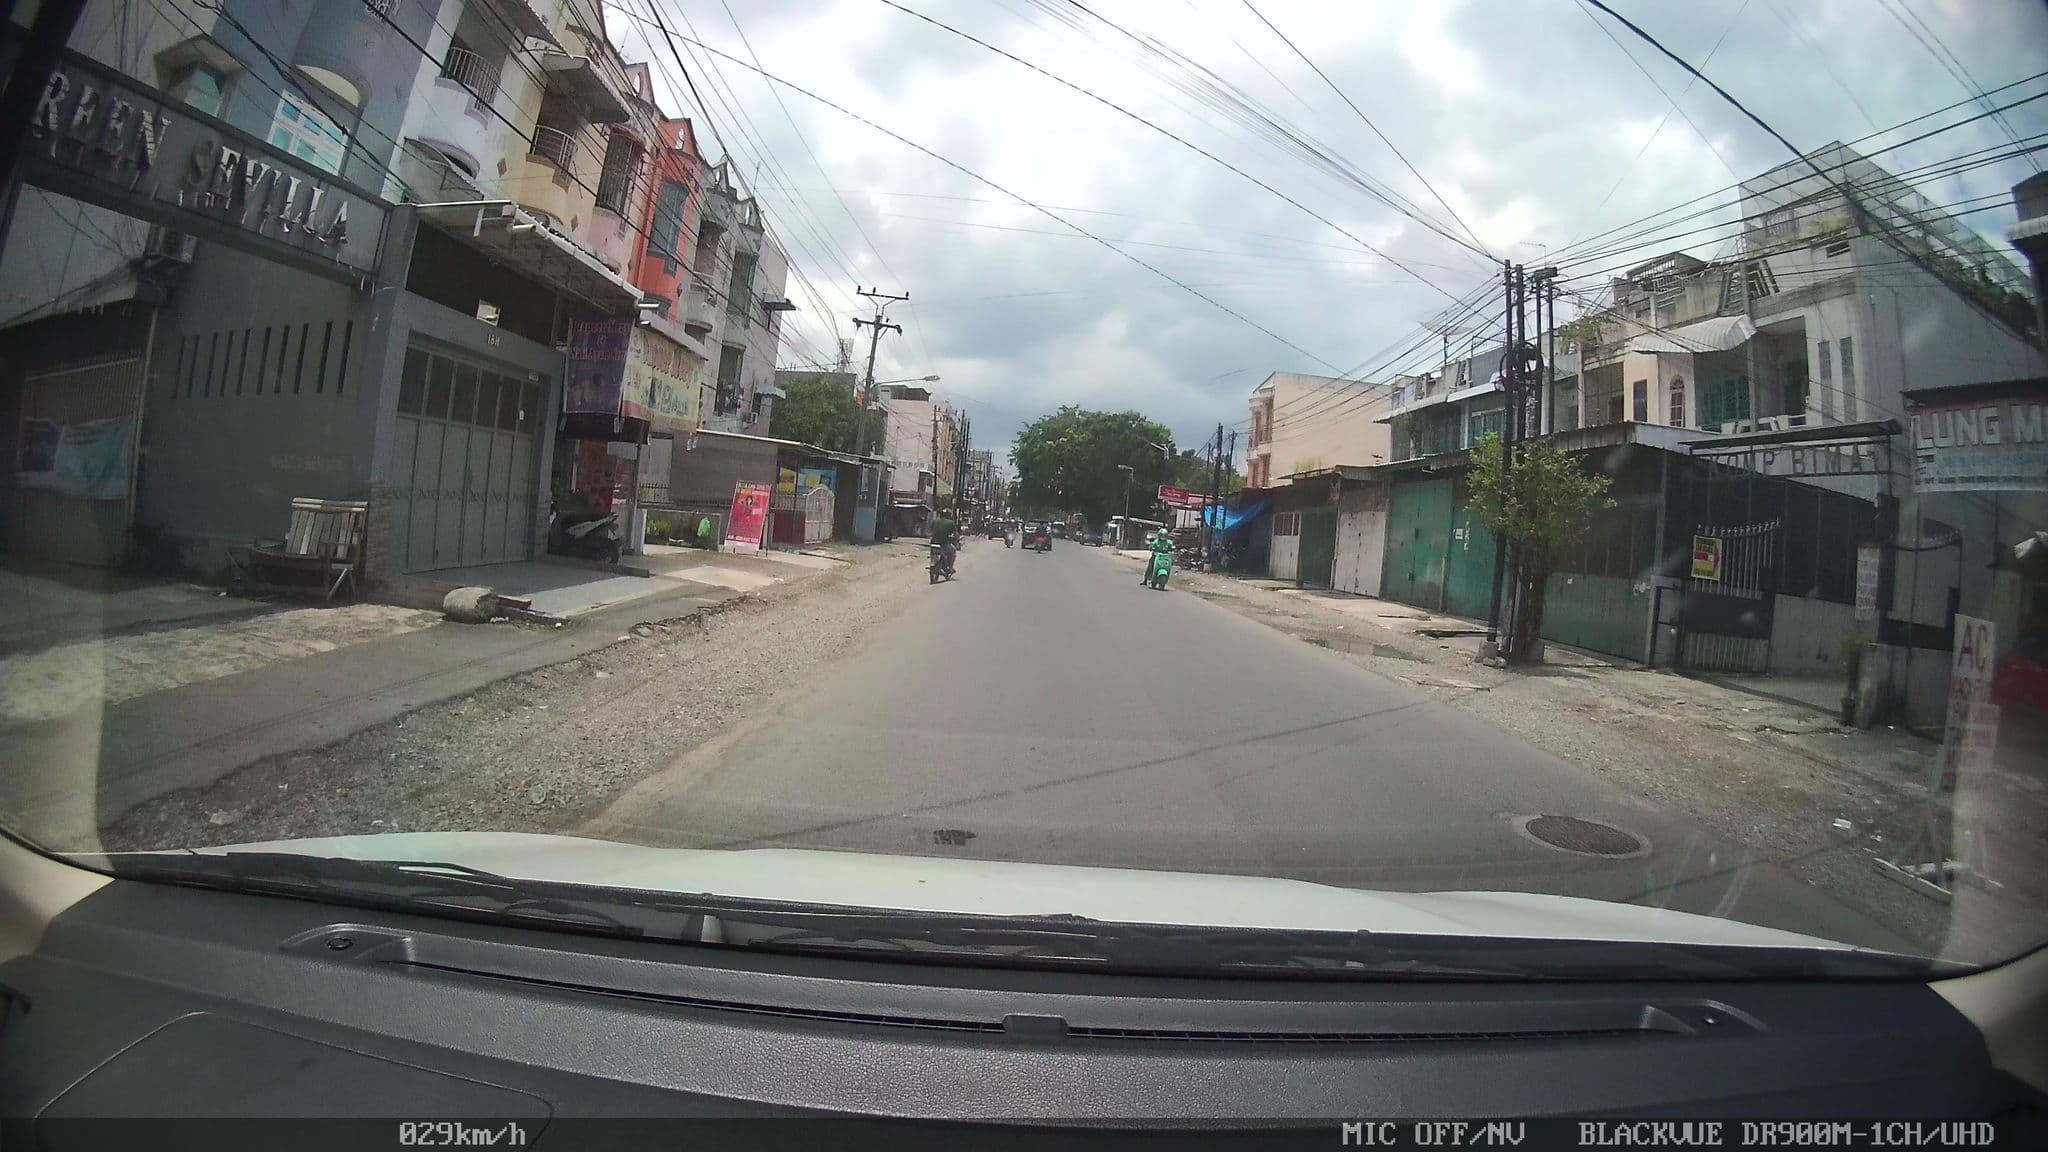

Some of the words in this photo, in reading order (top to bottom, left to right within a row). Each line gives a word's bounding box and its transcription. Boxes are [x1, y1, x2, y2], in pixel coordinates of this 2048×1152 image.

[185, 139, 347, 243] SEVILLA
[1911, 406, 2001, 450] LUNG
[2009, 404, 2048, 444] M
[1956, 621, 1988, 673] AC
